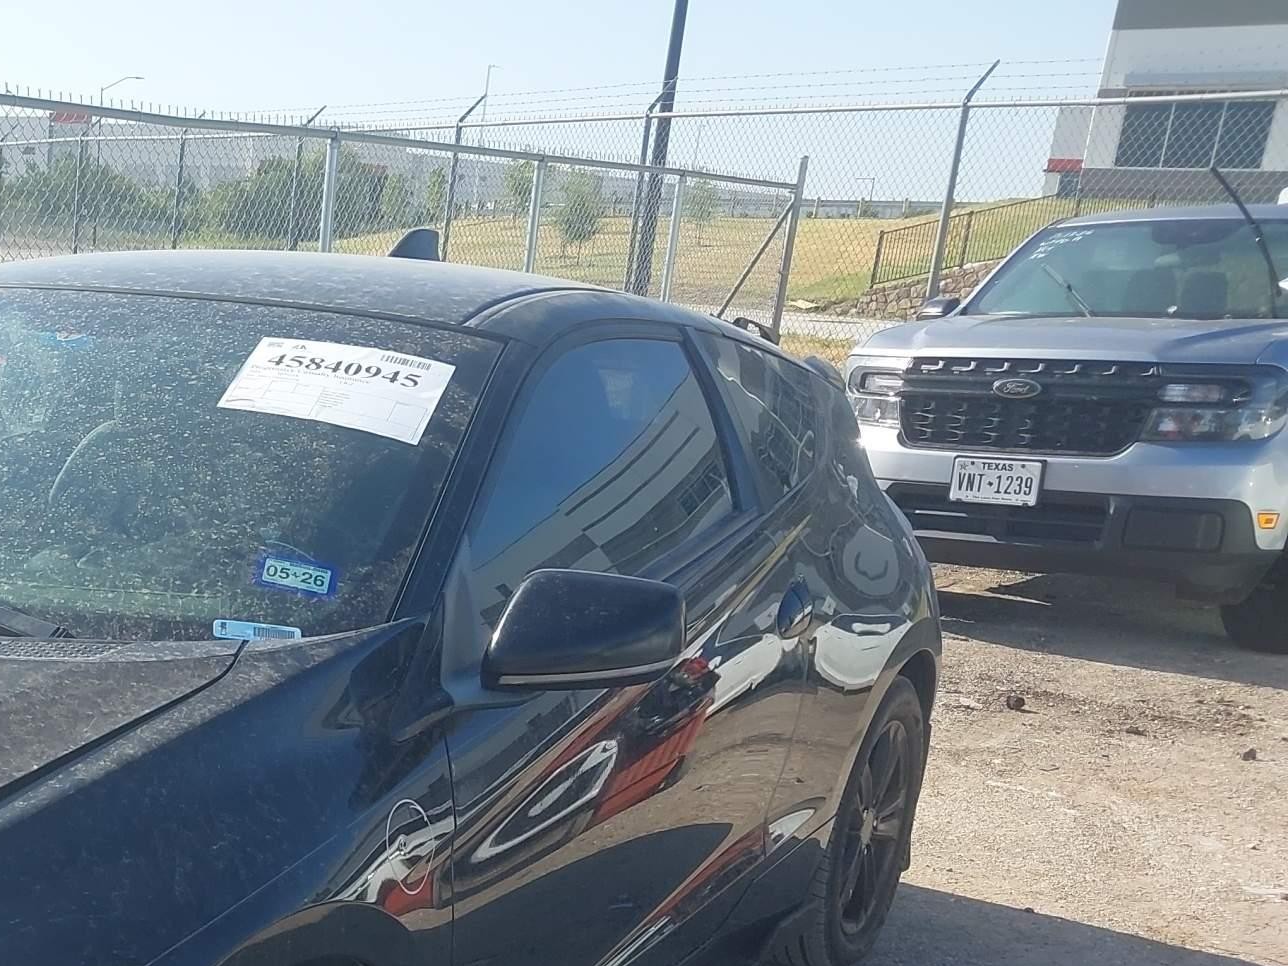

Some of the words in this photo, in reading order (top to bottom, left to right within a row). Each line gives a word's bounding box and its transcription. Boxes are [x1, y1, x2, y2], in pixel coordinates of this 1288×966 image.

[267, 353, 422, 388] 45840945
[1003, 382, 1030, 394] Ford
[982, 462, 1014, 472] TEXAS
[958, 472, 985, 493] VNT
[994, 474, 1033, 496] 1239
